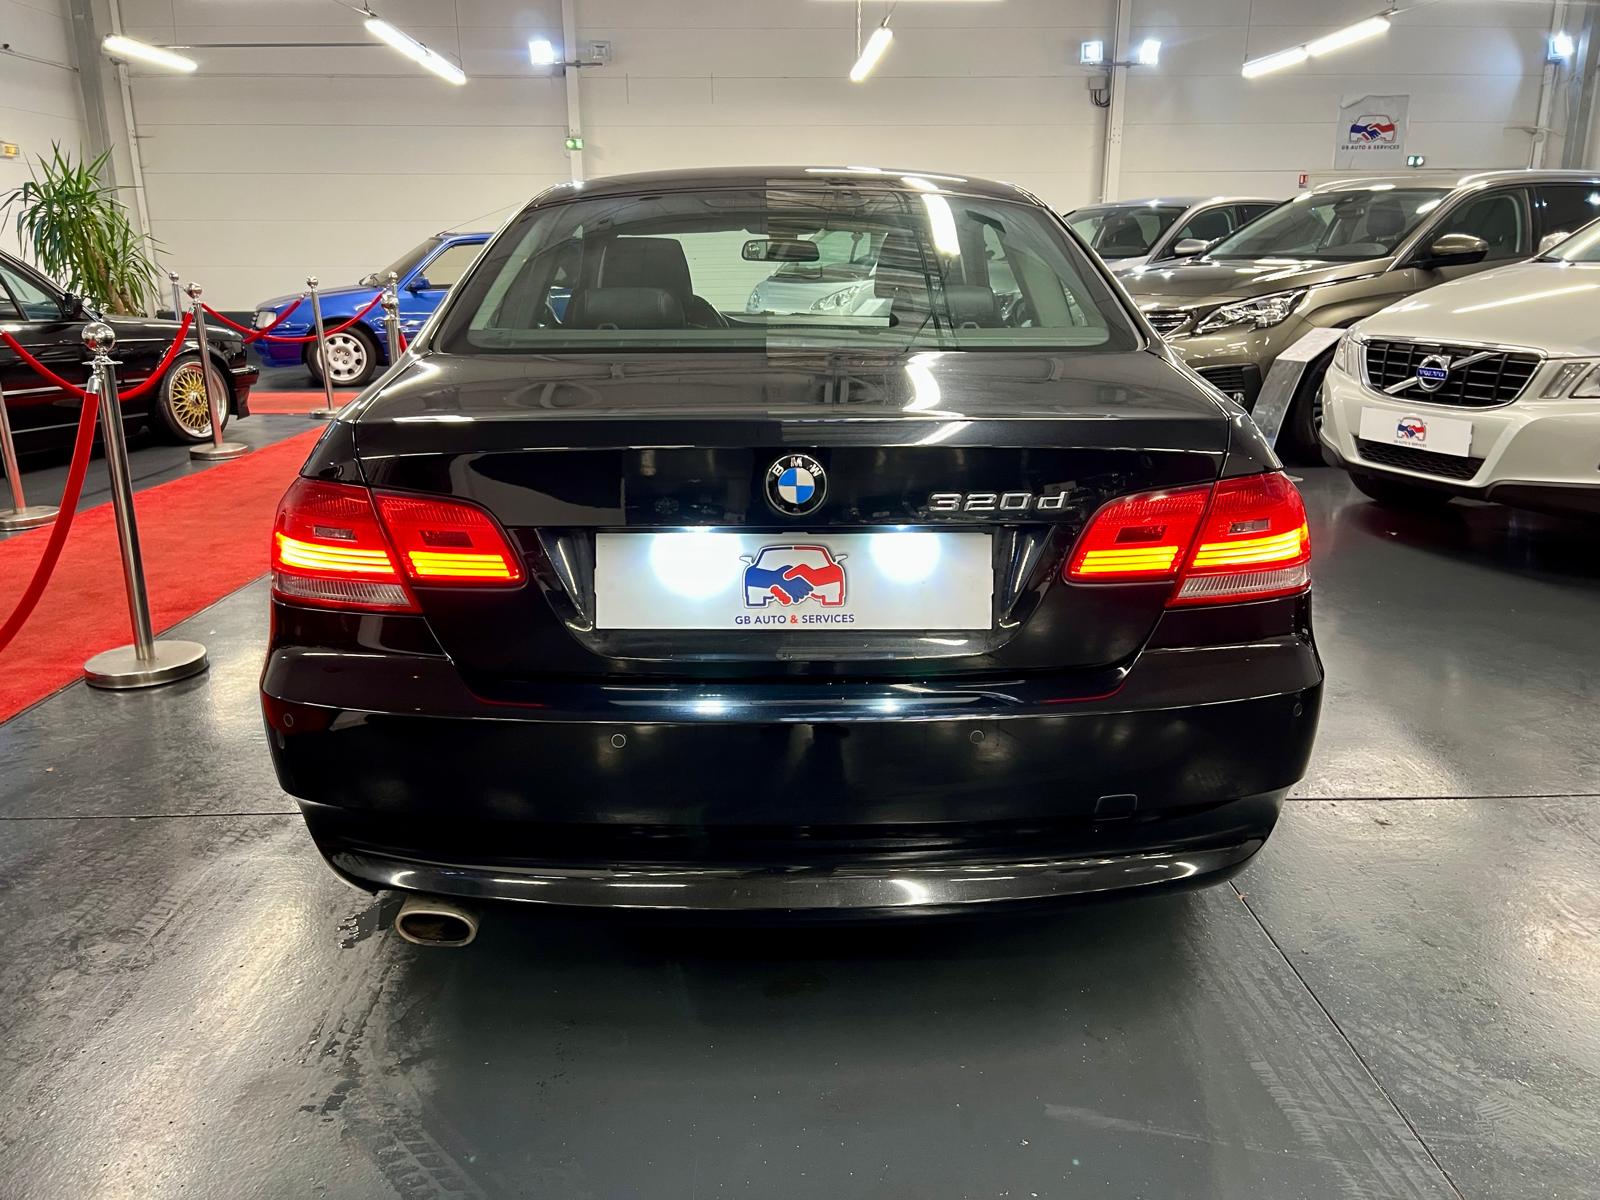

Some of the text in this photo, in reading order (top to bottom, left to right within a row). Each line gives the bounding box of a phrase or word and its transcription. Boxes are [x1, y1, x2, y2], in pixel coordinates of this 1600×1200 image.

[772, 457, 822, 477] BMW
[929, 491, 1068, 511] 320d
[735, 614, 855, 625] GB AUTO & SERVICES
